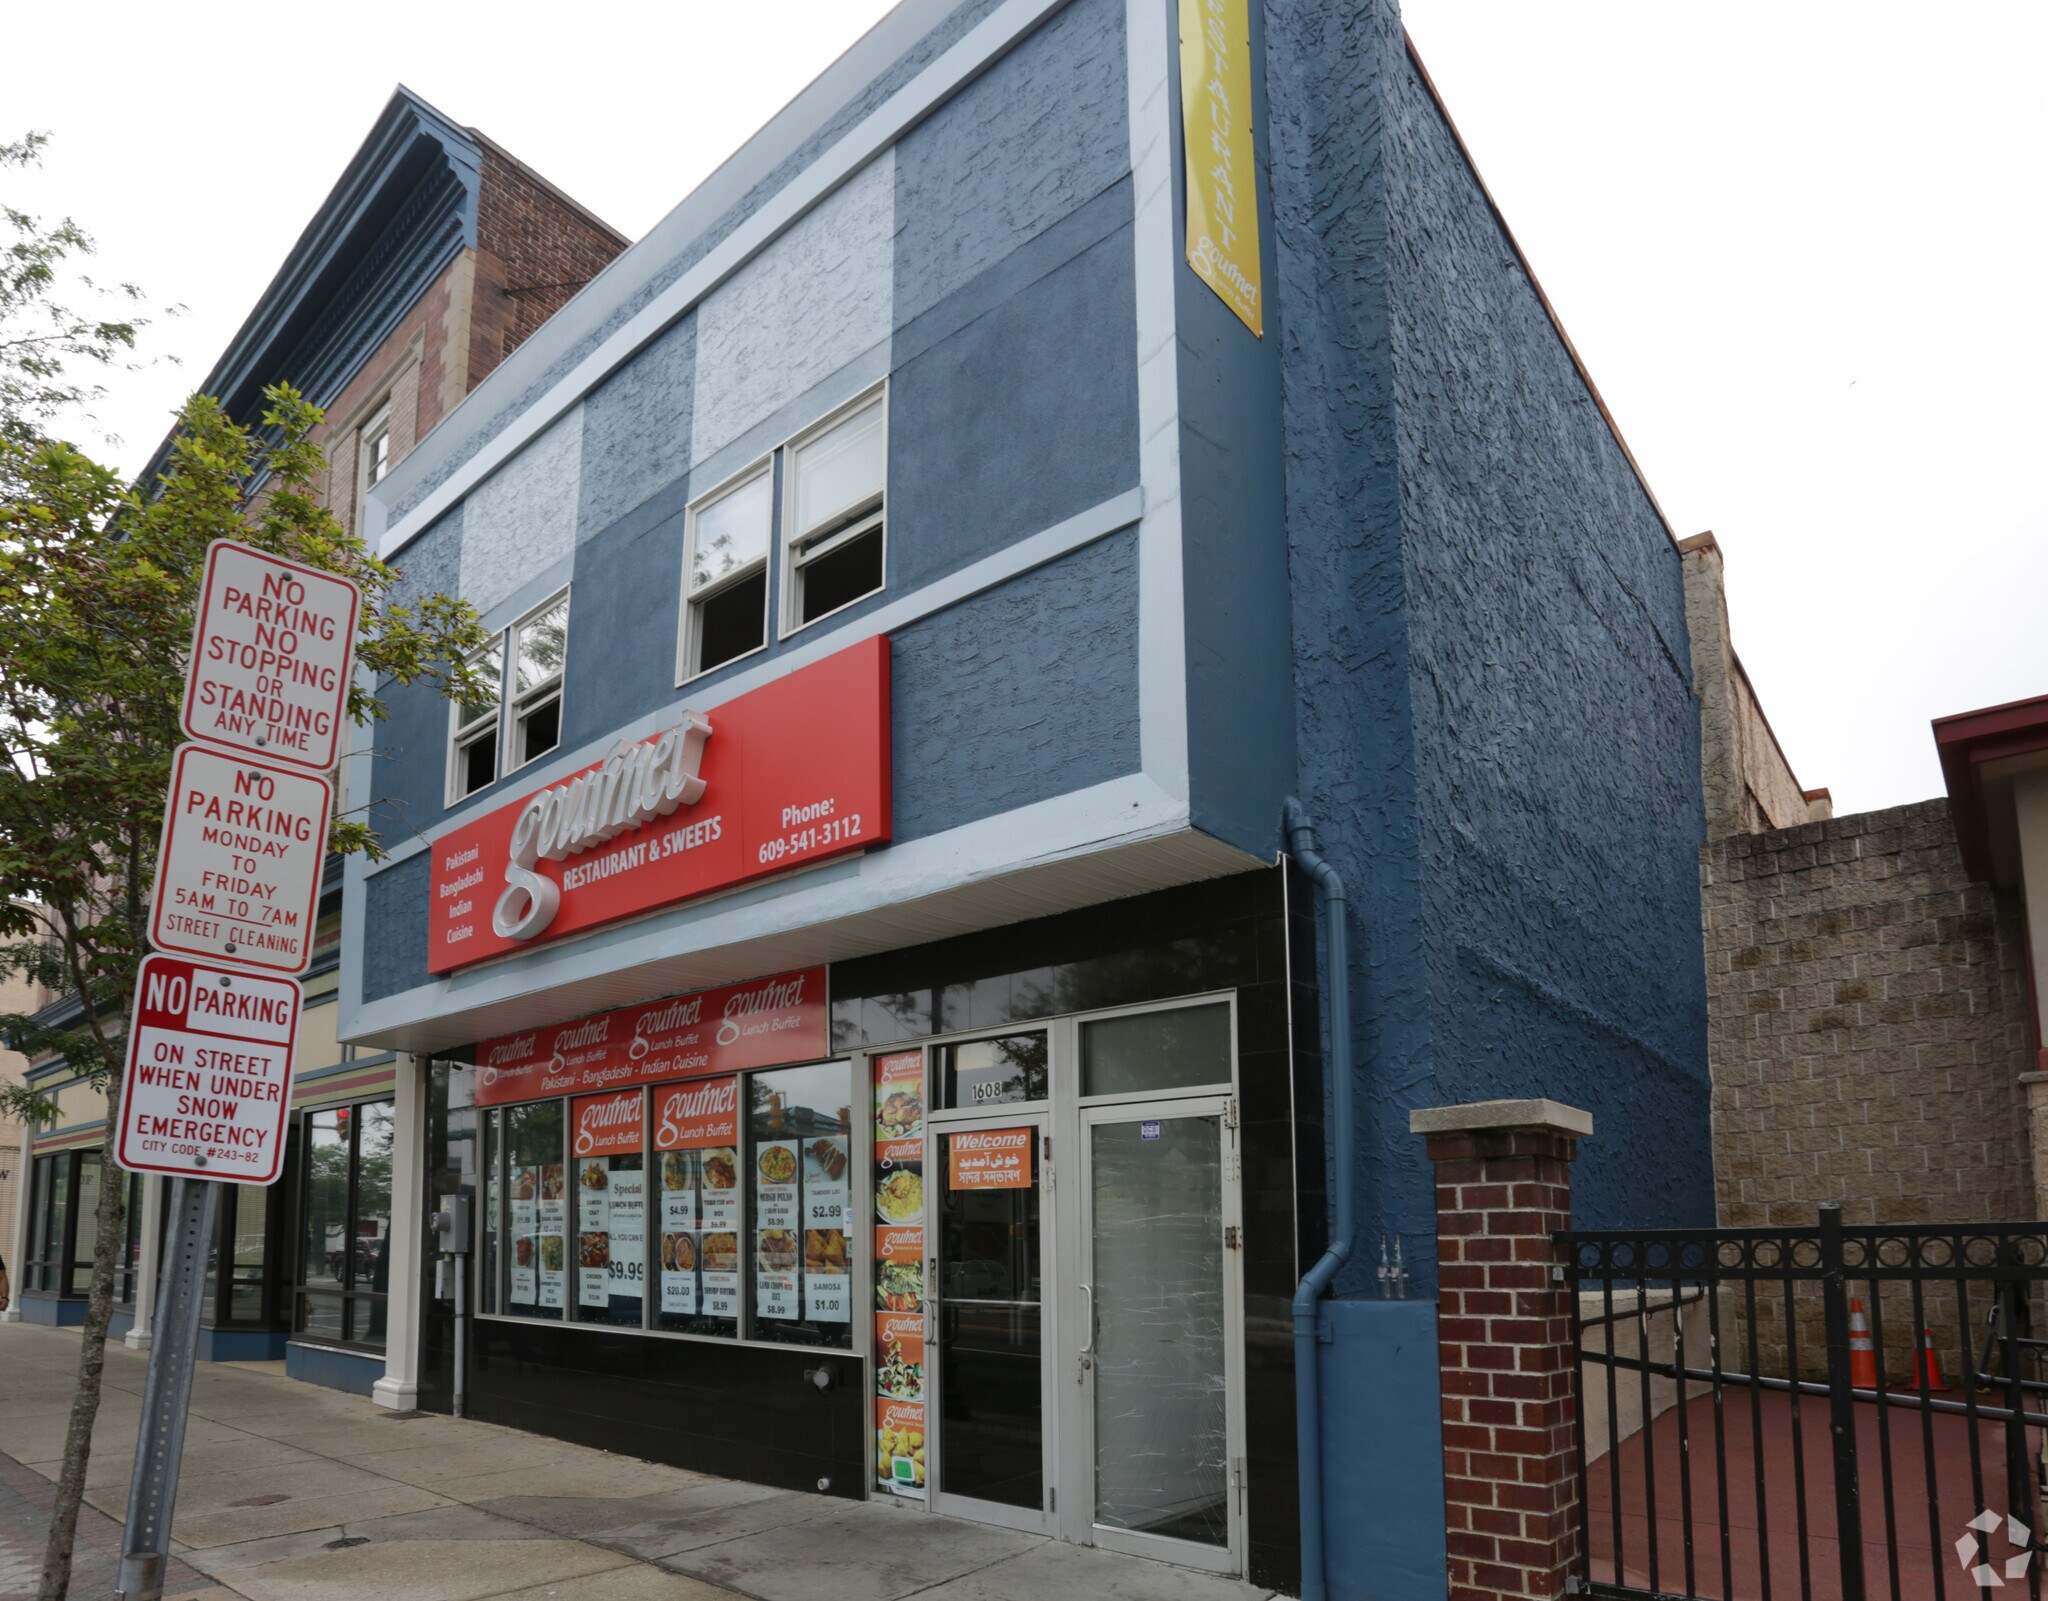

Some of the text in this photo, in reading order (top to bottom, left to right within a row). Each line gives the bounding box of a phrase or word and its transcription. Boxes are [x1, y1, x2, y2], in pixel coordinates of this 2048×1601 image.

[1192, 236, 1257, 305] gourmet
[263, 572, 305, 606] NO
[223, 586, 336, 641] PARKING
[255, 623, 298, 655] NO
[208, 636, 336, 692] STOPPING
[256, 675, 283, 698] OR
[200, 681, 330, 736] STANDING
[214, 711, 311, 752] ANY TIME
[234, 770, 275, 801] NO
[187, 790, 311, 842] PARKING
[492, 709, 713, 940] gourmet
[781, 797, 835, 829] Phone:
[202, 826, 289, 859] MONDAY
[758, 813, 861, 864] 609-541-3112
[232, 855, 257, 874] TO
[445, 843, 479, 872] Pakistani
[563, 815, 722, 892] RESTAURANT & SWEETS
[202, 871, 277, 900] FRIDAY
[439, 865, 484, 899] Bangladeshi
[175, 888, 298, 928] 5AM TO 7AM
[448, 898, 473, 919] Indian
[166, 914, 220, 939] STREET
[446, 923, 474, 944] Cuisine
[145, 972, 288, 1026] NO PARKING
[716, 974, 805, 1046] gourmet
[629, 996, 703, 1060] gourmet
[741, 1015, 801, 1036] Lunch Buffet
[549, 1016, 610, 1074] gourmet
[651, 1033, 699, 1051] Lunch Buffet
[153, 1042, 272, 1077] ON STREET
[482, 1033, 536, 1086] gourmet
[541, 1071, 577, 1091] Pakistani
[582, 1062, 634, 1087] Bangladeshi
[641, 1057, 670, 1075] Indian
[672, 1053, 708, 1070] Cuisine
[566, 1049, 607, 1066] Lunch Buffet
[881, 1054, 922, 1084] gourmet
[139, 1064, 281, 1103] WHEN UNDER
[972, 1081, 1001, 1099] 1608
[176, 1095, 239, 1121] SNOW
[656, 1080, 737, 1148] gourmet
[136, 1114, 268, 1148] EMERGENCY
[575, 1092, 643, 1154] gourmet
[680, 1122, 733, 1139] Lunch Buffet
[142, 1139, 259, 1163] CITY CODE #243-82
[595, 1132, 640, 1147] Lunch Buffet
[956, 1133, 1027, 1150] Welcome
[881, 1141, 922, 1169] gourmet
[614, 1183, 642, 1197] Special
[608, 1201, 627, 1210] LUNCH
[669, 1205, 688, 1216] $4.99
[812, 1205, 841, 1218] $2.99
[767, 1218, 785, 1226] $8.99
[881, 1229, 923, 1256] gourmet
[608, 1261, 643, 1281] $9.99
[667, 1285, 690, 1296] $20.00
[813, 1283, 841, 1291] SAMOSA
[712, 1301, 728, 1311] $8.99
[767, 1305, 785, 1314] $8.99
[815, 1300, 840, 1311] $1.00
[882, 1317, 924, 1342] gourmet
[882, 1404, 924, 1429] gourmet
